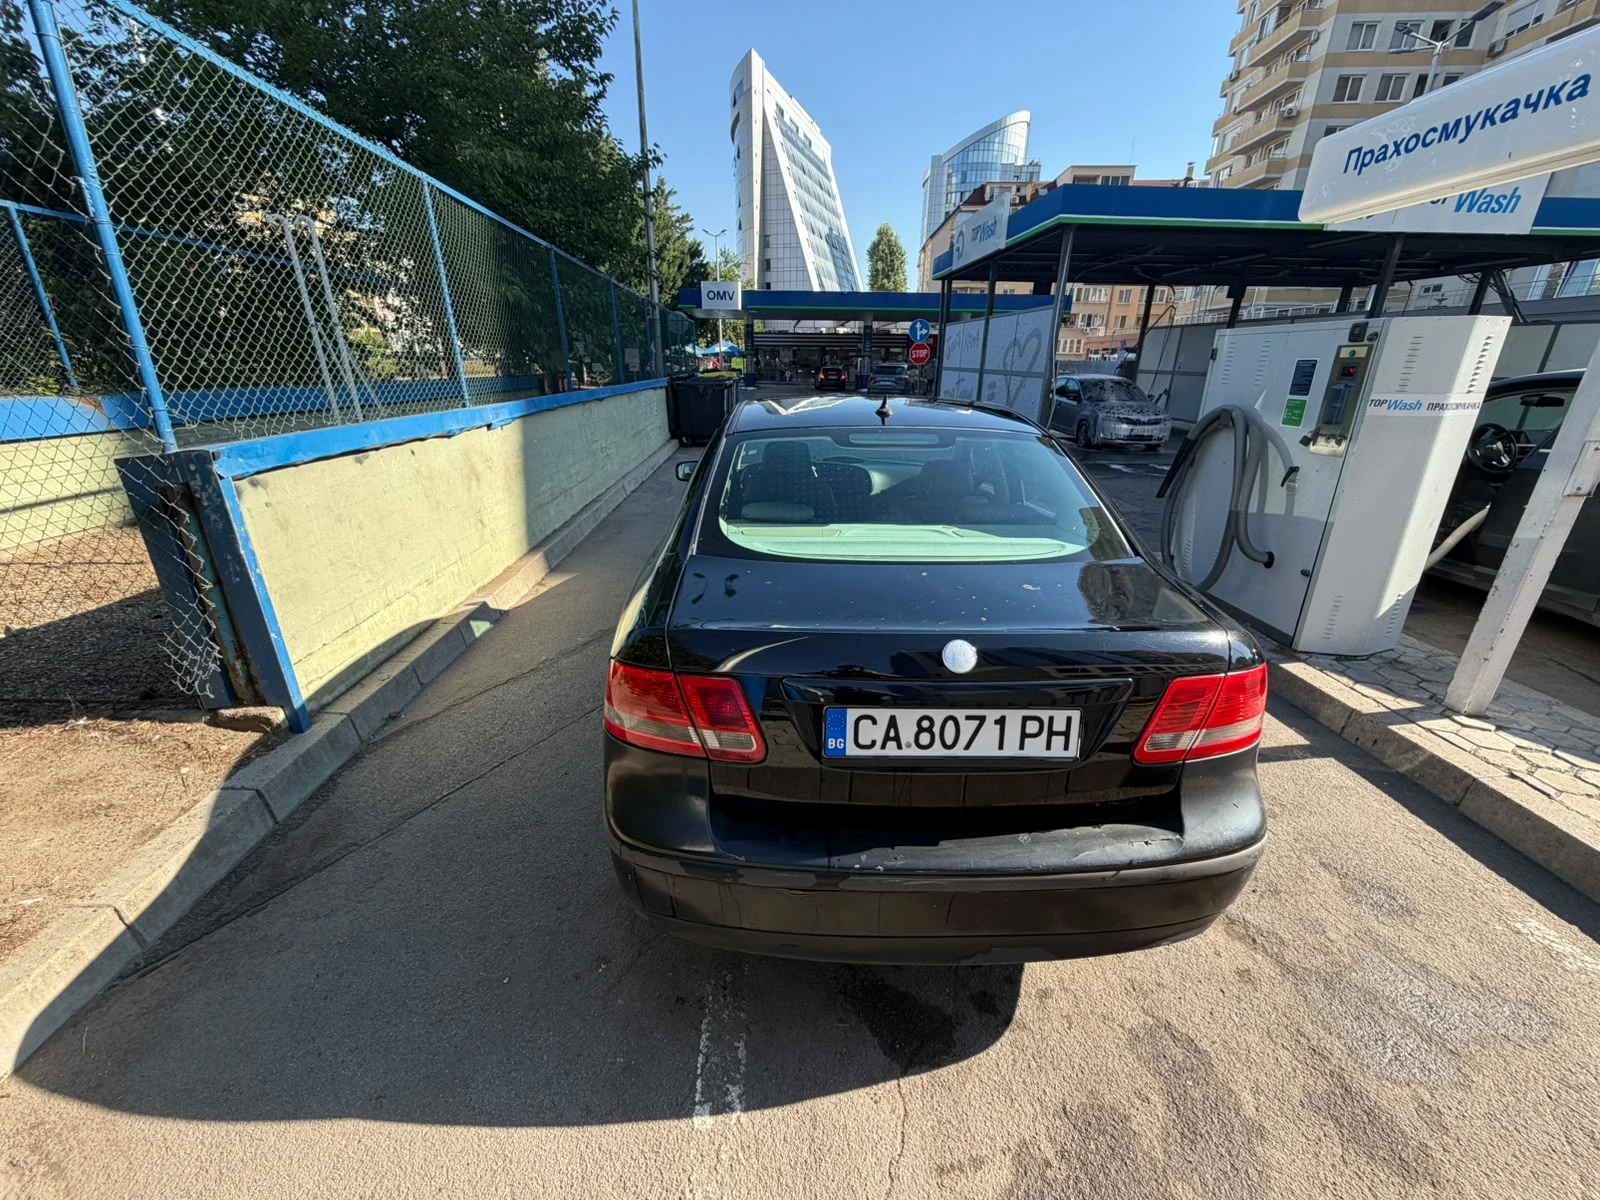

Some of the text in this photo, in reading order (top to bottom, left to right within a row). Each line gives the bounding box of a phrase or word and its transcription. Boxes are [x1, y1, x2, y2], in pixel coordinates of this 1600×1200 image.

[1343, 73, 1592, 176] Прахосмукачка
[706, 289, 735, 301] OMV
[911, 349, 928, 359] STOP
[853, 714, 1073, 751] CA 8071 PH
[828, 738, 845, 749] BG
